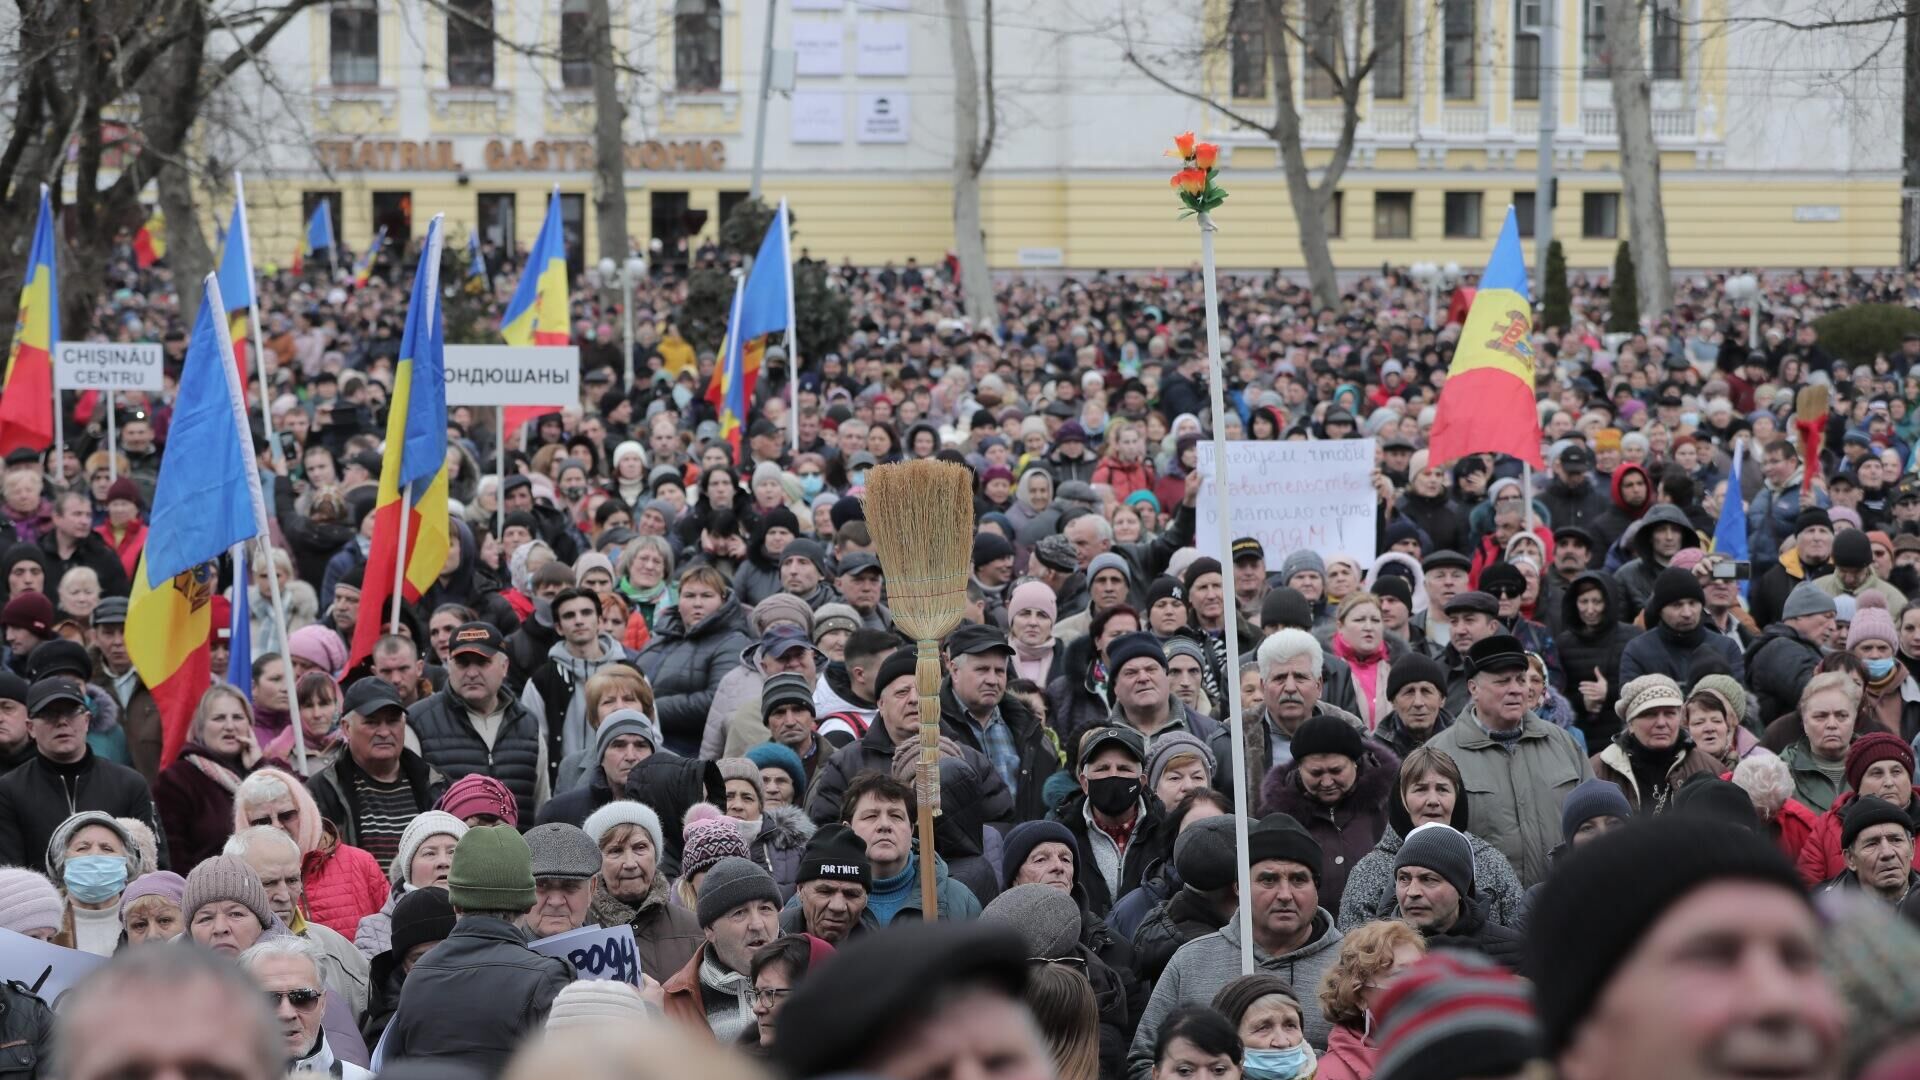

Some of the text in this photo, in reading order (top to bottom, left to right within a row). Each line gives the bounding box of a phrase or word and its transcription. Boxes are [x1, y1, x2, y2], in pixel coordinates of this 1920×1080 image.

[314, 139, 725, 172] TEATRUL GASTRNOMIC
[74, 370, 144, 384] CENTRU
[1207, 472, 1361, 496] павительство
